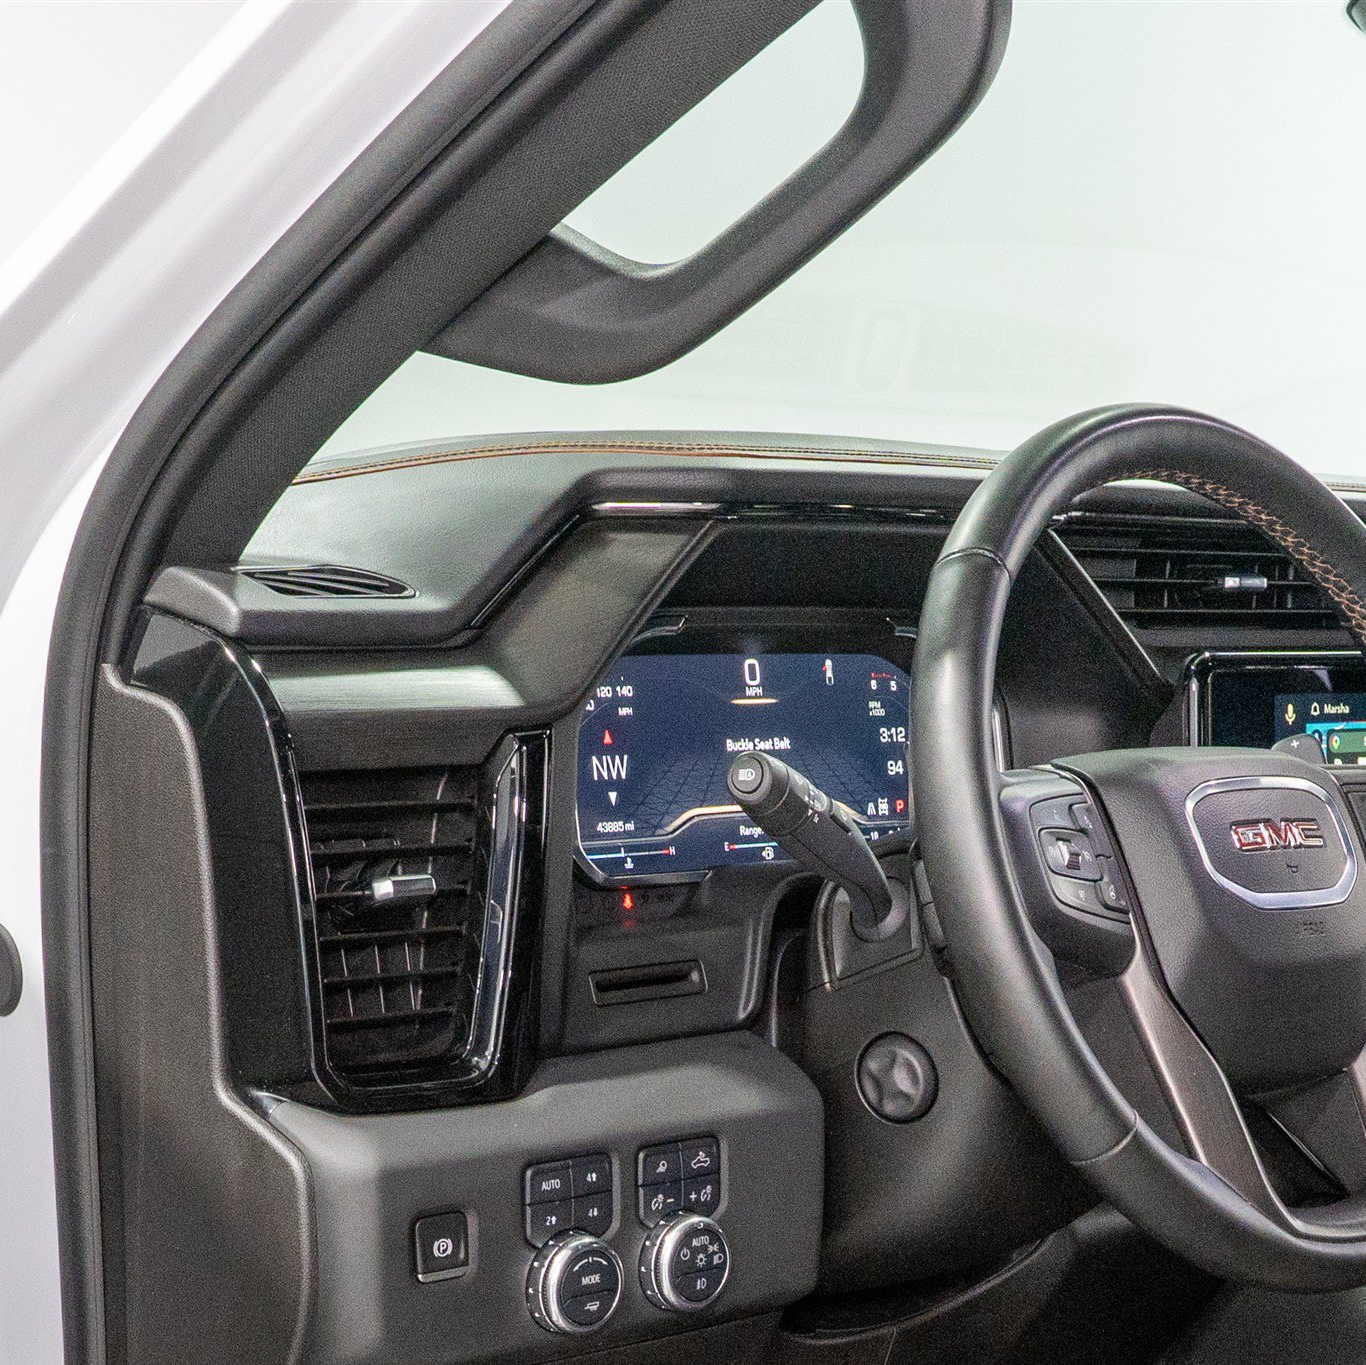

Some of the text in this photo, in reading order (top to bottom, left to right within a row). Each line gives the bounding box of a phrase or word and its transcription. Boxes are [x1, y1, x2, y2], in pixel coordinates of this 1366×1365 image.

[744, 658, 761, 686] 0
[596, 685, 633, 698] 120 140
[745, 686, 763, 697] MPH
[890, 680, 897, 691] 5
[618, 707, 633, 717] MPH
[1323, 703, 1350, 714] Marsha
[879, 727, 906, 743] 3:12
[726, 736, 791, 752] Buckle Seat Belt
[592, 754, 628, 781] NW
[887, 760, 904, 776] 94
[895, 799, 905, 813] P
[596, 820, 635, 834] 43885 mi
[1231, 819, 1324, 851] GMC
[669, 846, 676, 856] H
[541, 1178, 561, 1191] AUTO
[691, 1235, 710, 1248] AUTO
[581, 1273, 601, 1286] MODE
